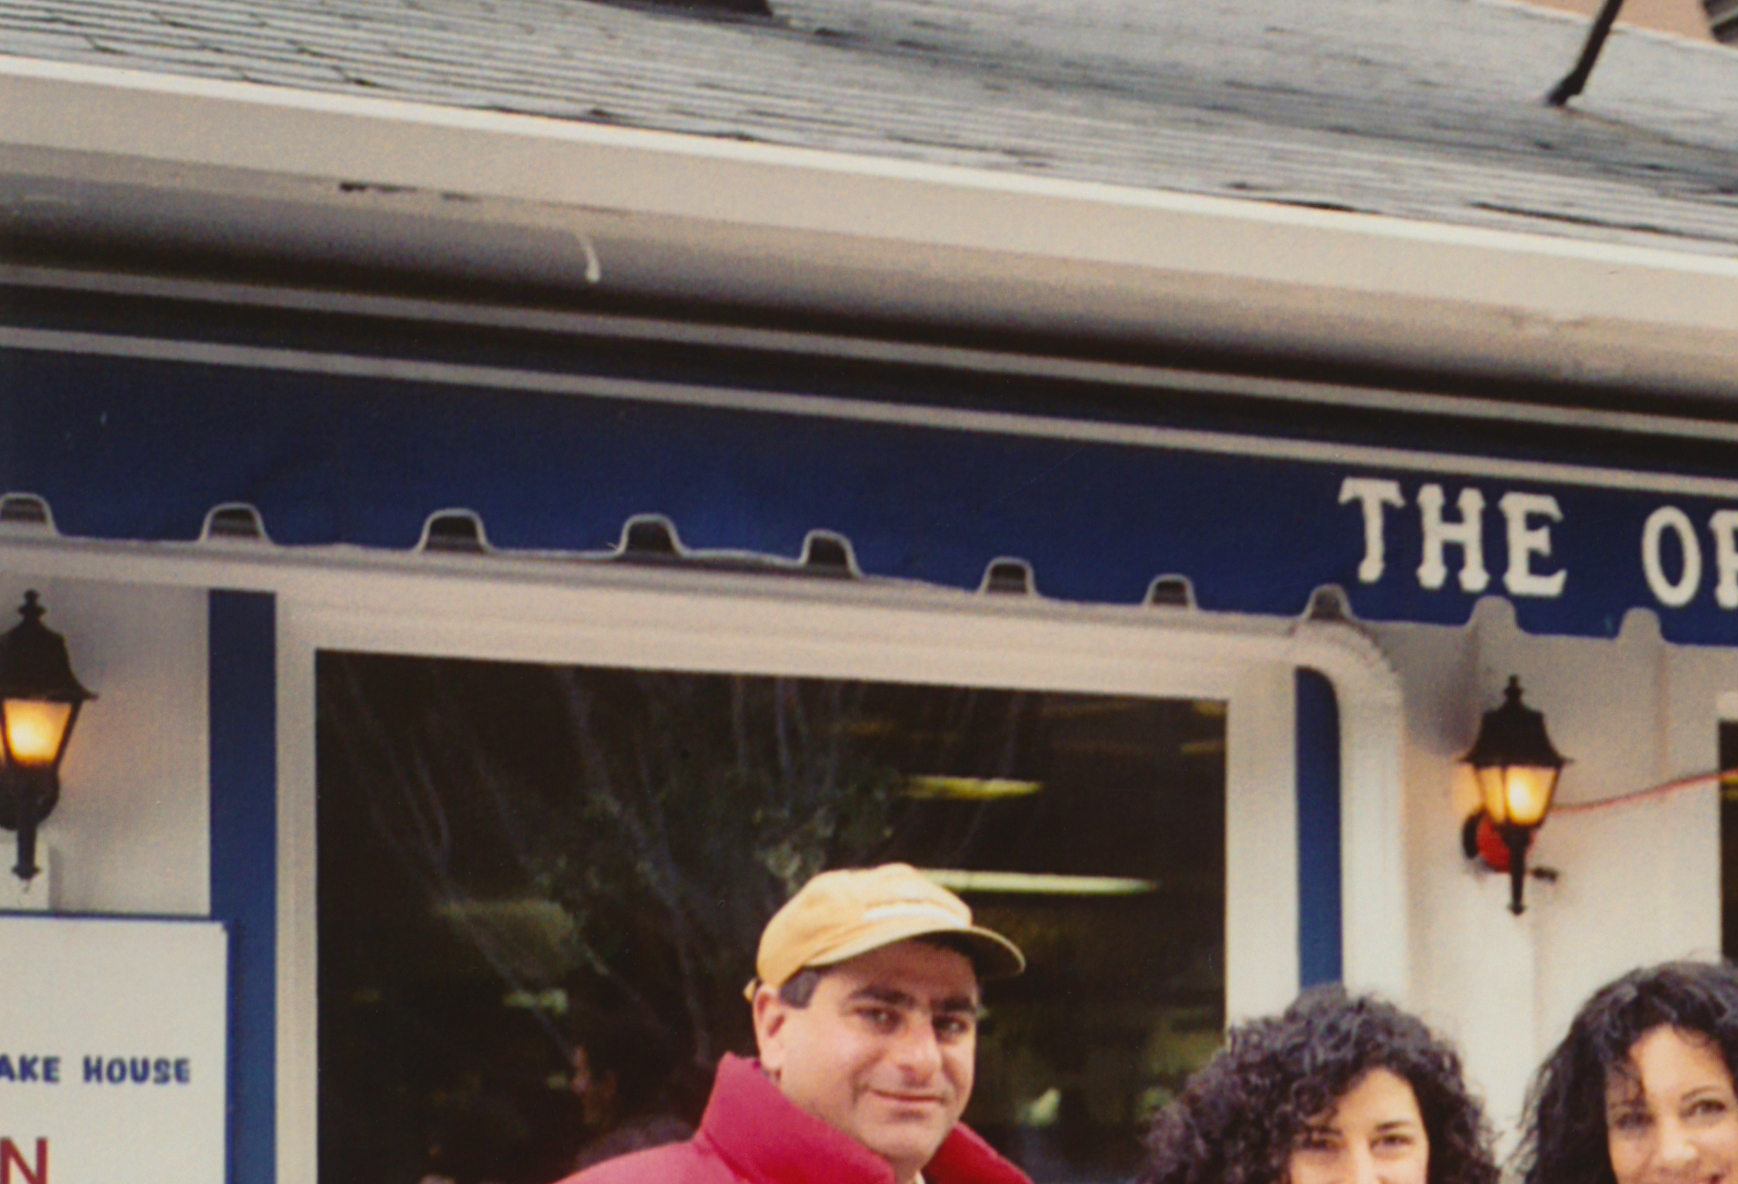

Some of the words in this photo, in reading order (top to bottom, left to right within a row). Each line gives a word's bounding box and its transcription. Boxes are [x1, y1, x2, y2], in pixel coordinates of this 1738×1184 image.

[1339, 477, 1568, 597] THE
[0, 1053, 61, 1084] AKE
[82, 1056, 191, 1085] HOUSE
